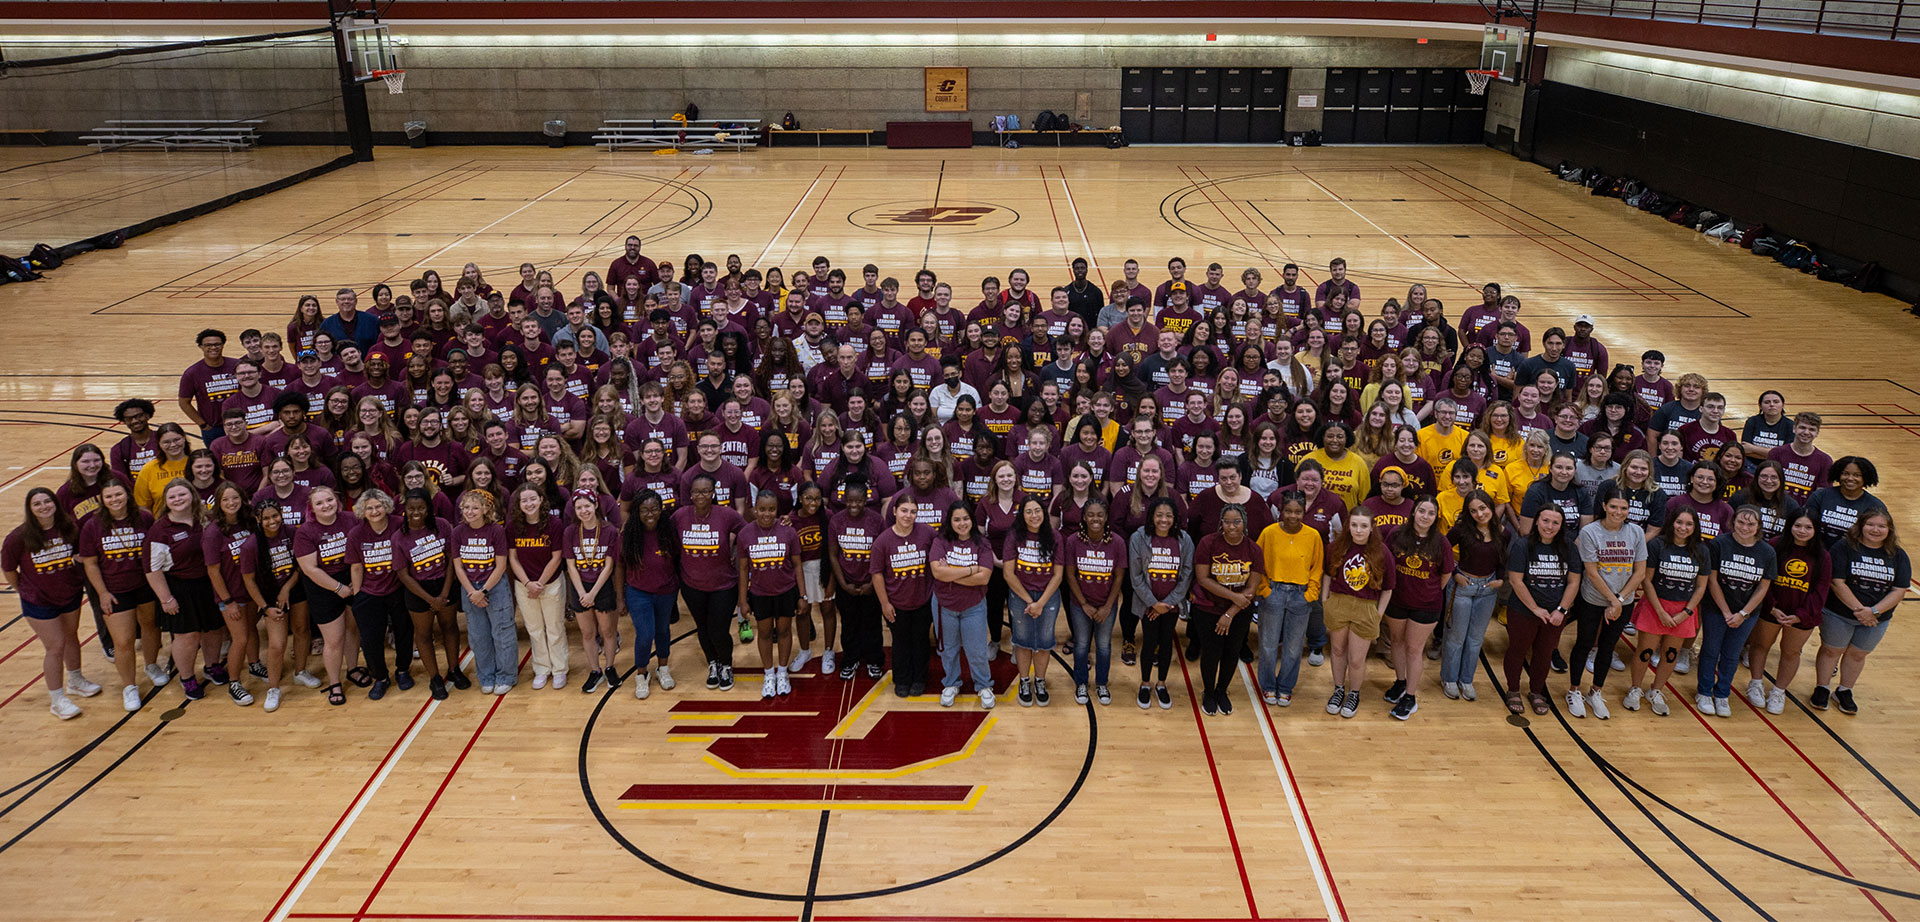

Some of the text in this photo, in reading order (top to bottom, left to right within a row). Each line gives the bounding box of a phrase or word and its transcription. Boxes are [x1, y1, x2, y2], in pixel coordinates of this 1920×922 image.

[721, 441, 748, 454] ENTRA
[1836, 506, 1858, 516] WE DO
[846, 527, 865, 536] WE DO
[1670, 554, 1692, 564] WE DO
[1732, 554, 1755, 566] WE DO
[1659, 560, 1694, 572] LEARNING
[1720, 560, 1756, 574] LEARNING
[1850, 561, 1887, 574] LEARNING
[1720, 567, 1763, 582] COMMUNITY
[1850, 569, 1894, 582] COMMUNITY
